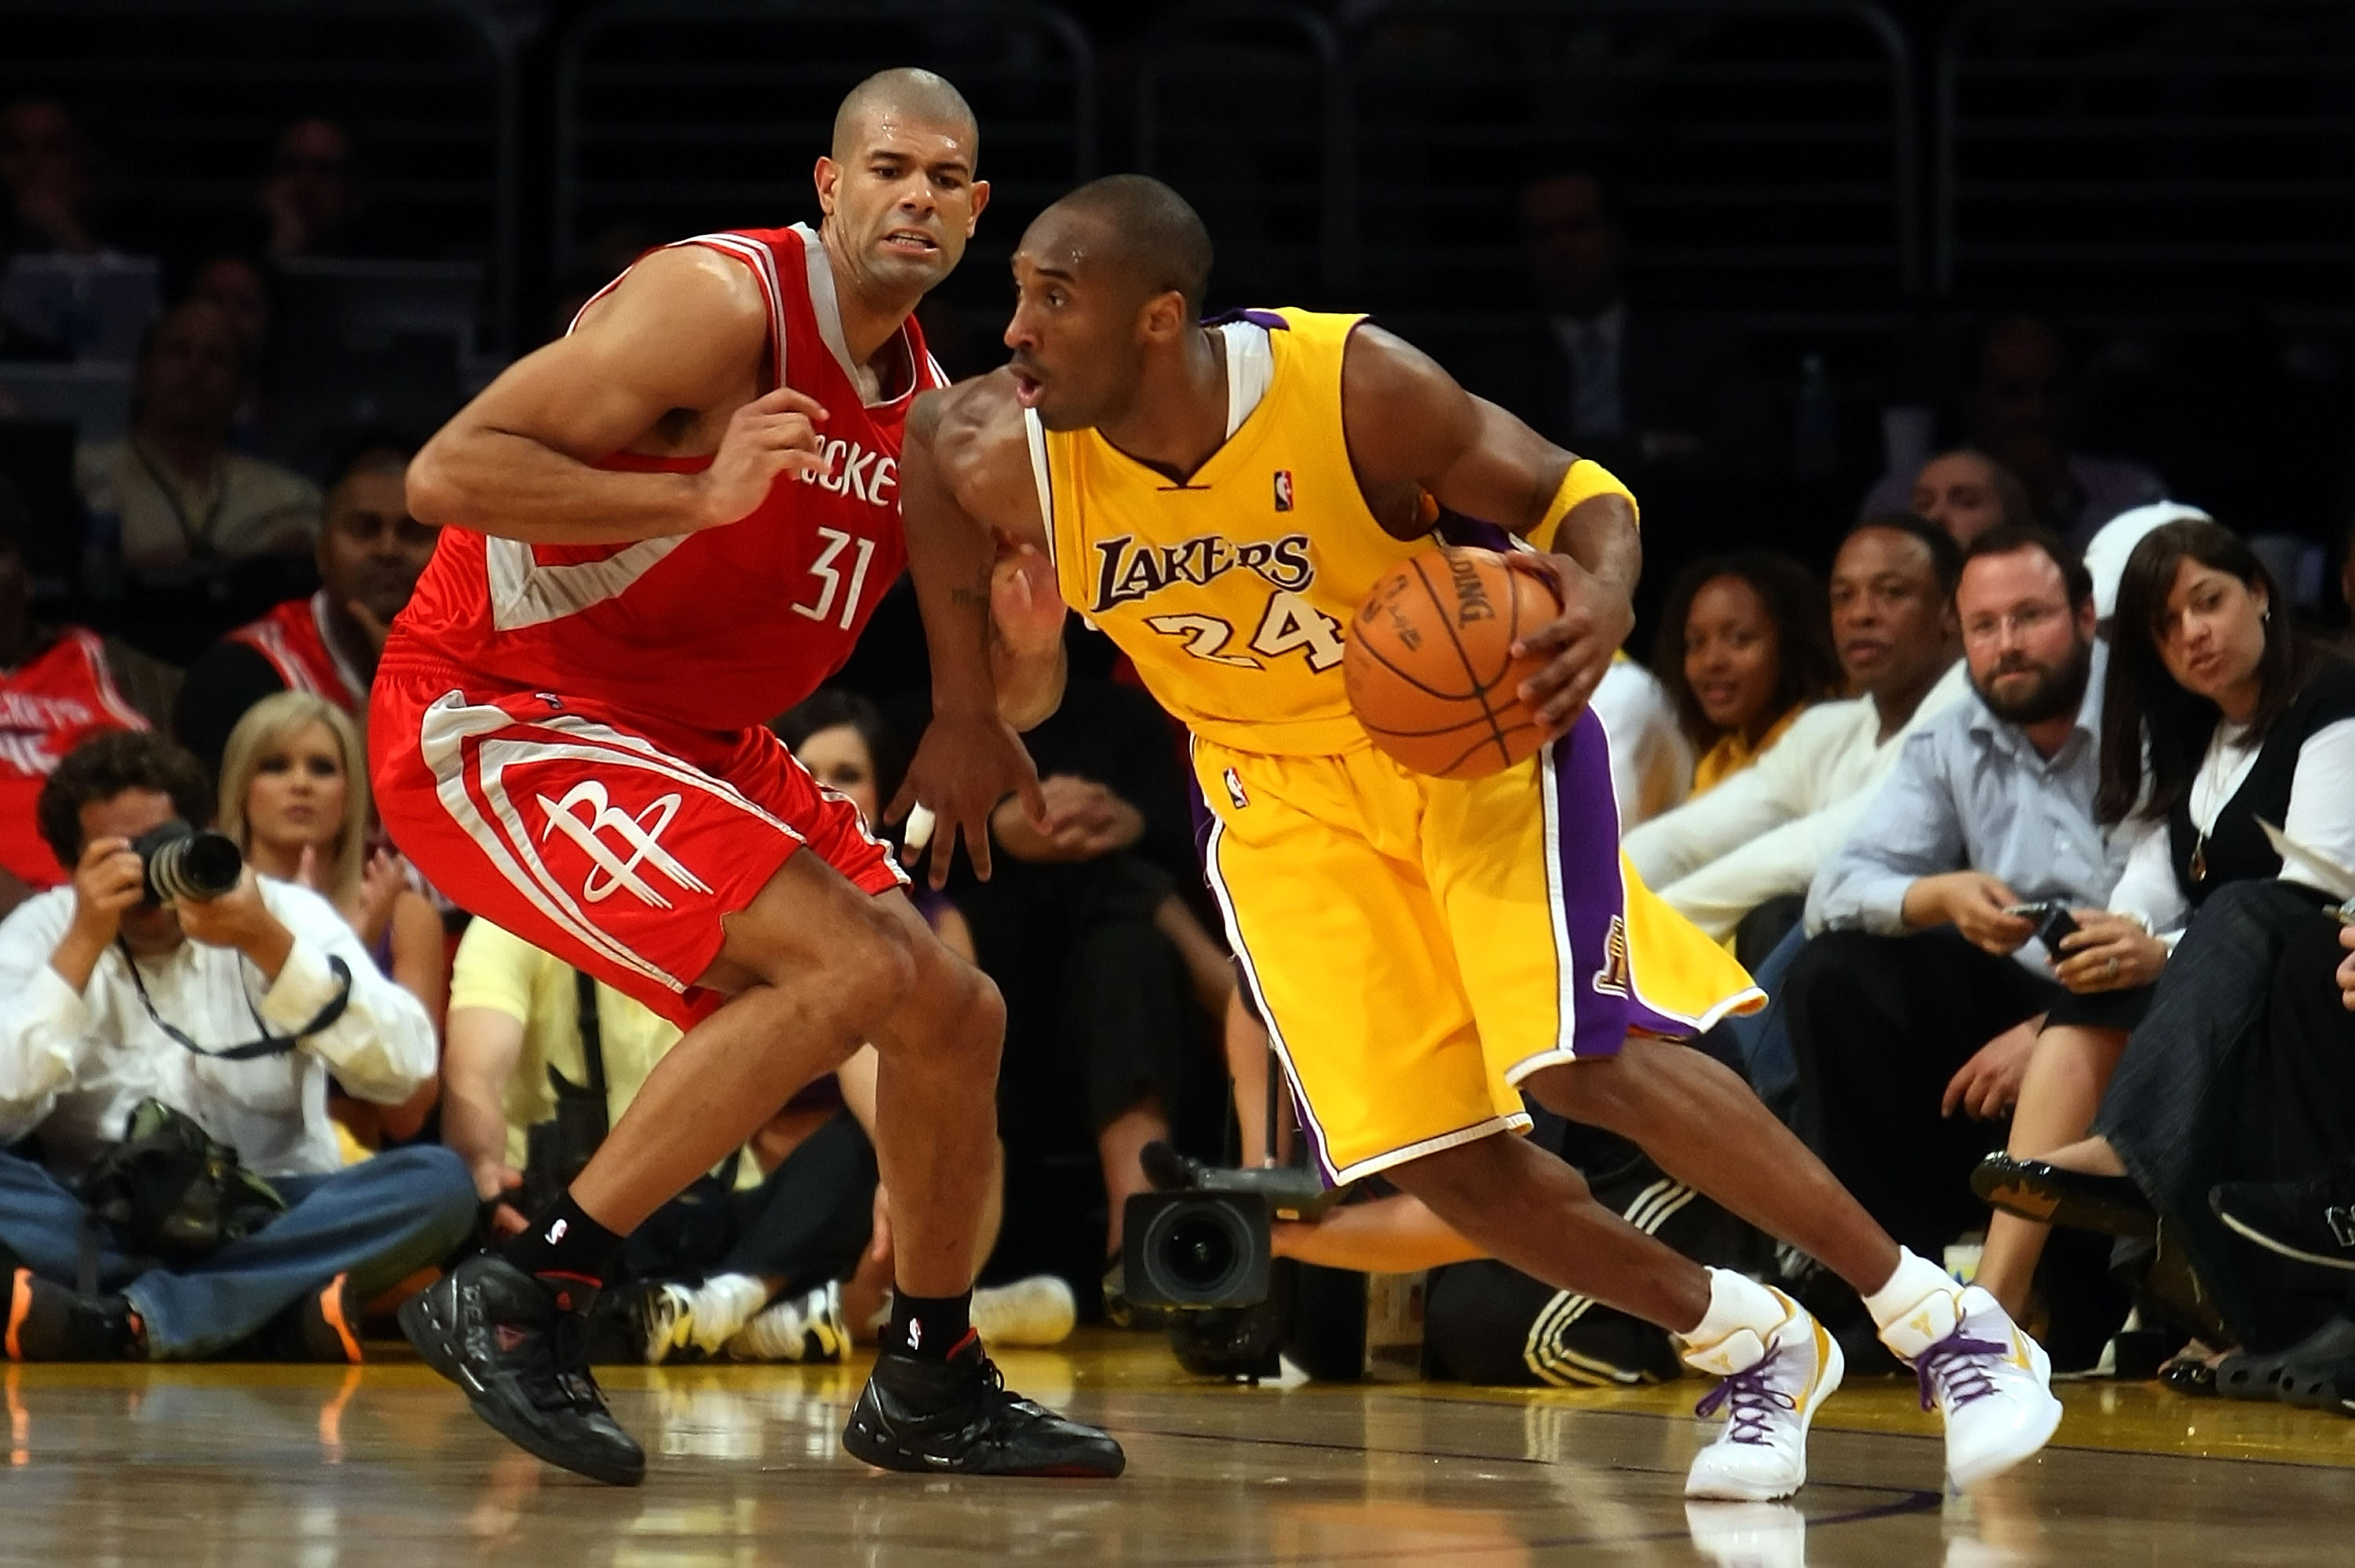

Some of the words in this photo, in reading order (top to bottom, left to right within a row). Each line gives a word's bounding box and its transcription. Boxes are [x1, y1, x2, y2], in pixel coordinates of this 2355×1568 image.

[791, 526, 875, 631] 31
[1090, 532, 1316, 613] LAKERS
[1142, 589, 1345, 674] 24
